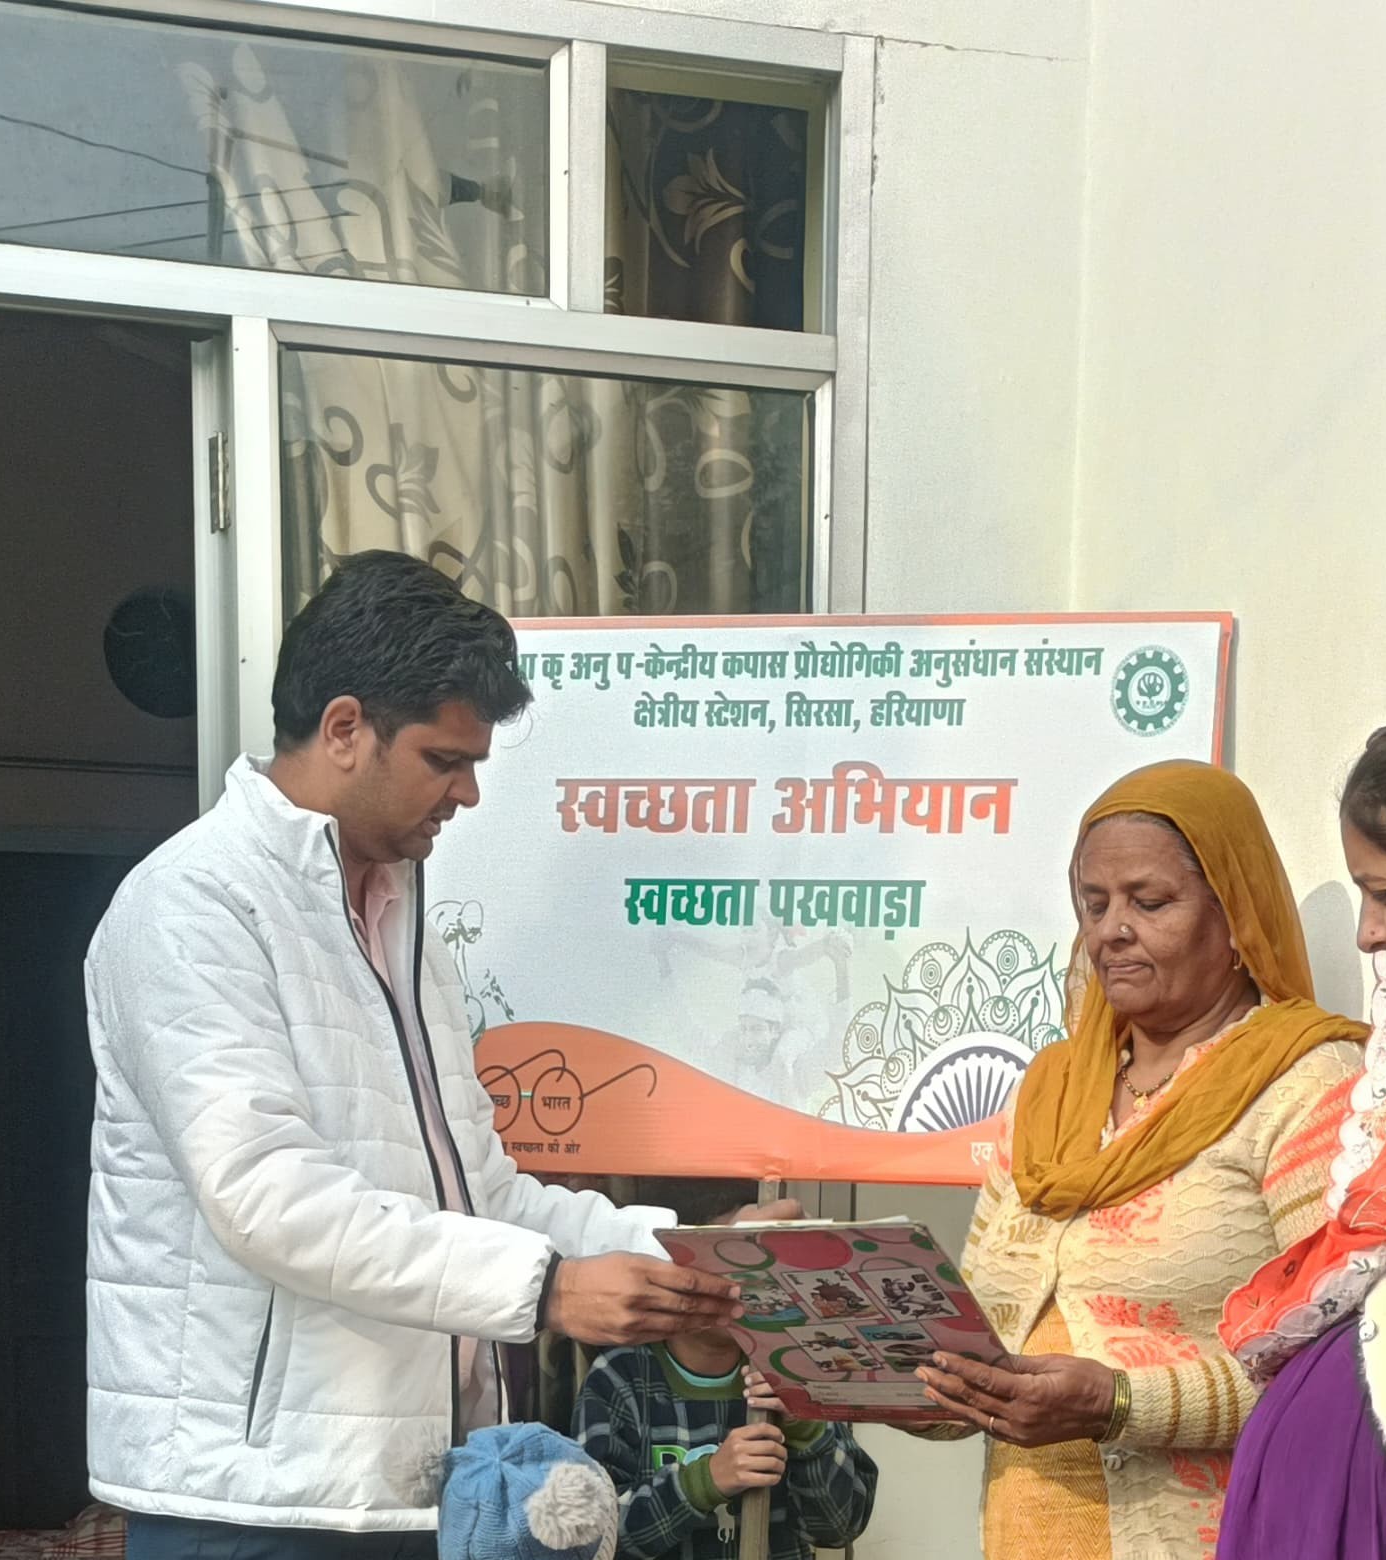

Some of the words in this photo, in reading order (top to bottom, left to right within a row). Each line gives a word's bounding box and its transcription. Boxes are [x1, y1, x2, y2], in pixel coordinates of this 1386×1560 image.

[541, 653, 565, 690] कृ
[570, 652, 611, 690] अनु
[722, 651, 789, 679] कपास
[794, 641, 904, 680] प्रौद्योगिकी
[909, 639, 1018, 688] अनुसंधान
[1024, 638, 1104, 676] संस्थान
[634, 691, 699, 727] क्षेत्रीय
[704, 691, 776, 733] स्टेशन,
[785, 690, 861, 733] सिरसा,
[870, 690, 966, 726] हरियाणा
[556, 778, 757, 833] स्वच्छता
[772, 760, 1018, 834] अभियान
[624, 878, 760, 926] स्वच्छता
[769, 879, 926, 940] पखवाड़ा
[541, 1096, 571, 1110] भारत
[512, 1142, 544, 1153] स्वच्छता
[565, 1140, 581, 1153] ओर
